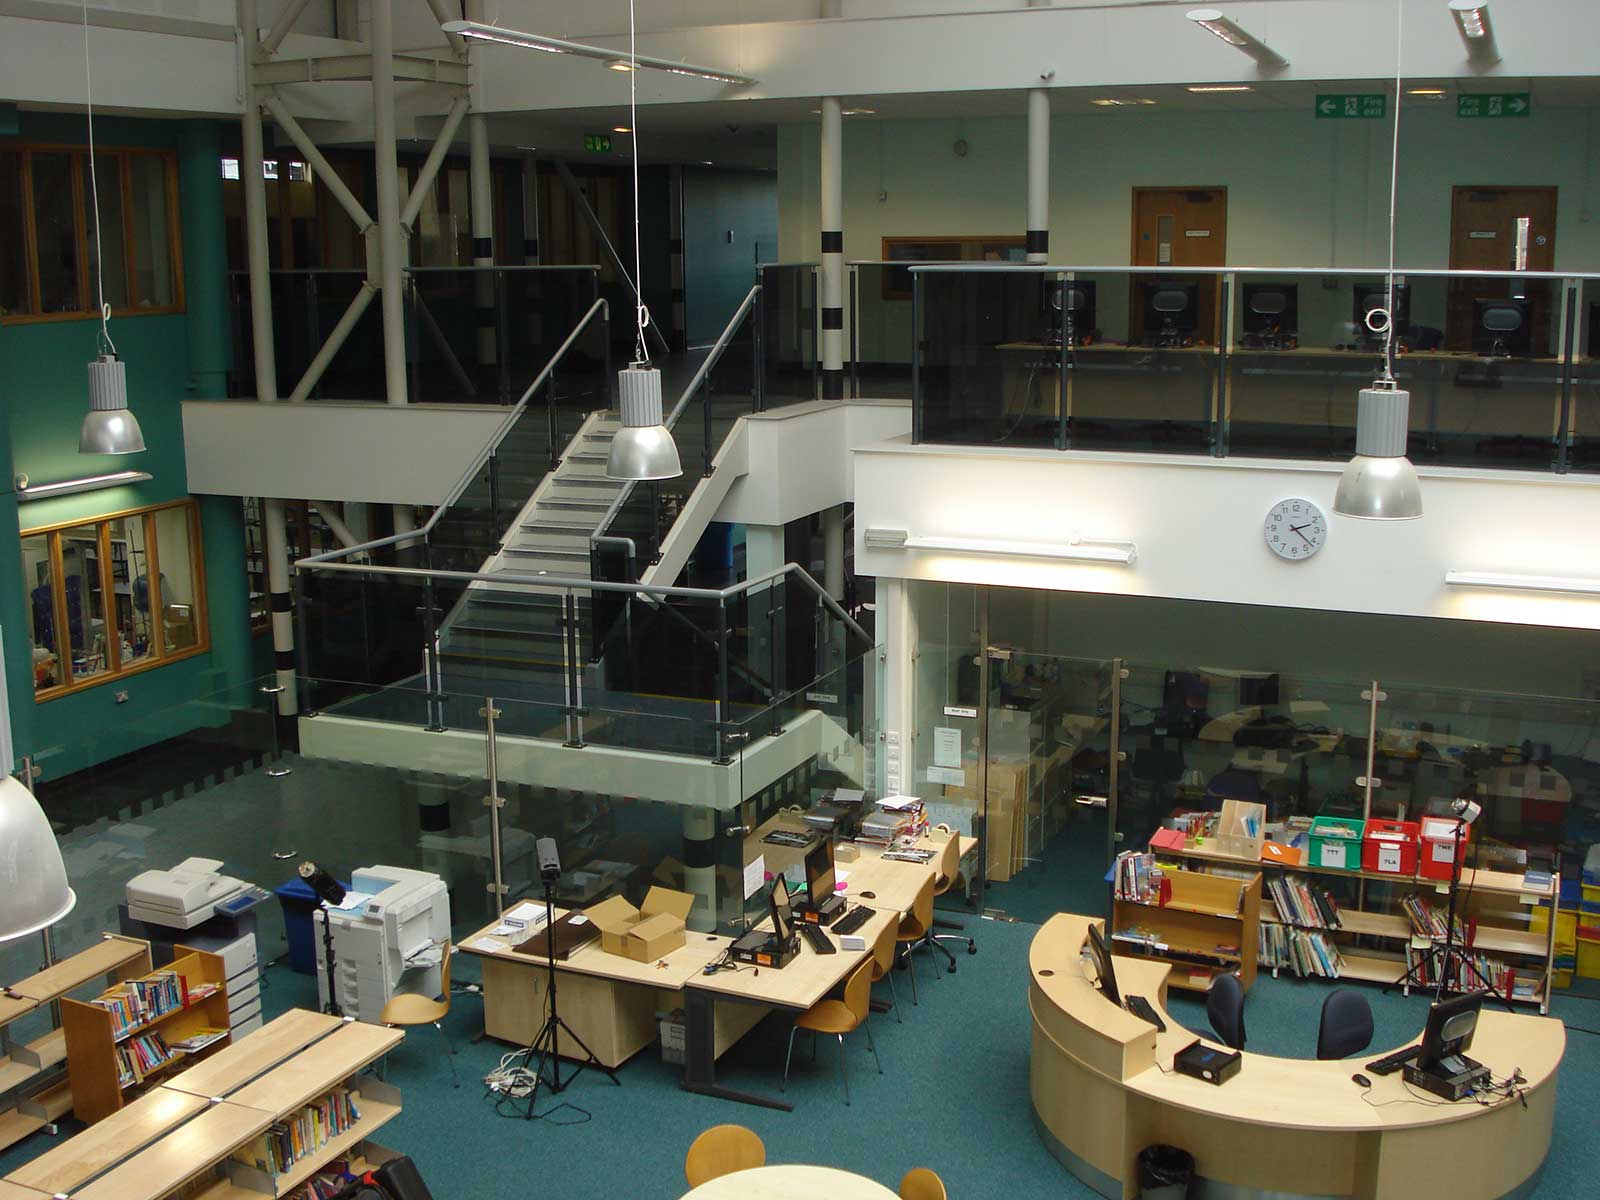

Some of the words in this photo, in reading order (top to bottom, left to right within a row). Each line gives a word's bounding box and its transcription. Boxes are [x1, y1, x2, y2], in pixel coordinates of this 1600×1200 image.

[1363, 97, 1383, 106] Fire
[1363, 107, 1382, 116] exit
[1292, 504, 1300, 512] 12
[1280, 543, 1287, 551] 7
[1291, 546, 1298, 554] 6
